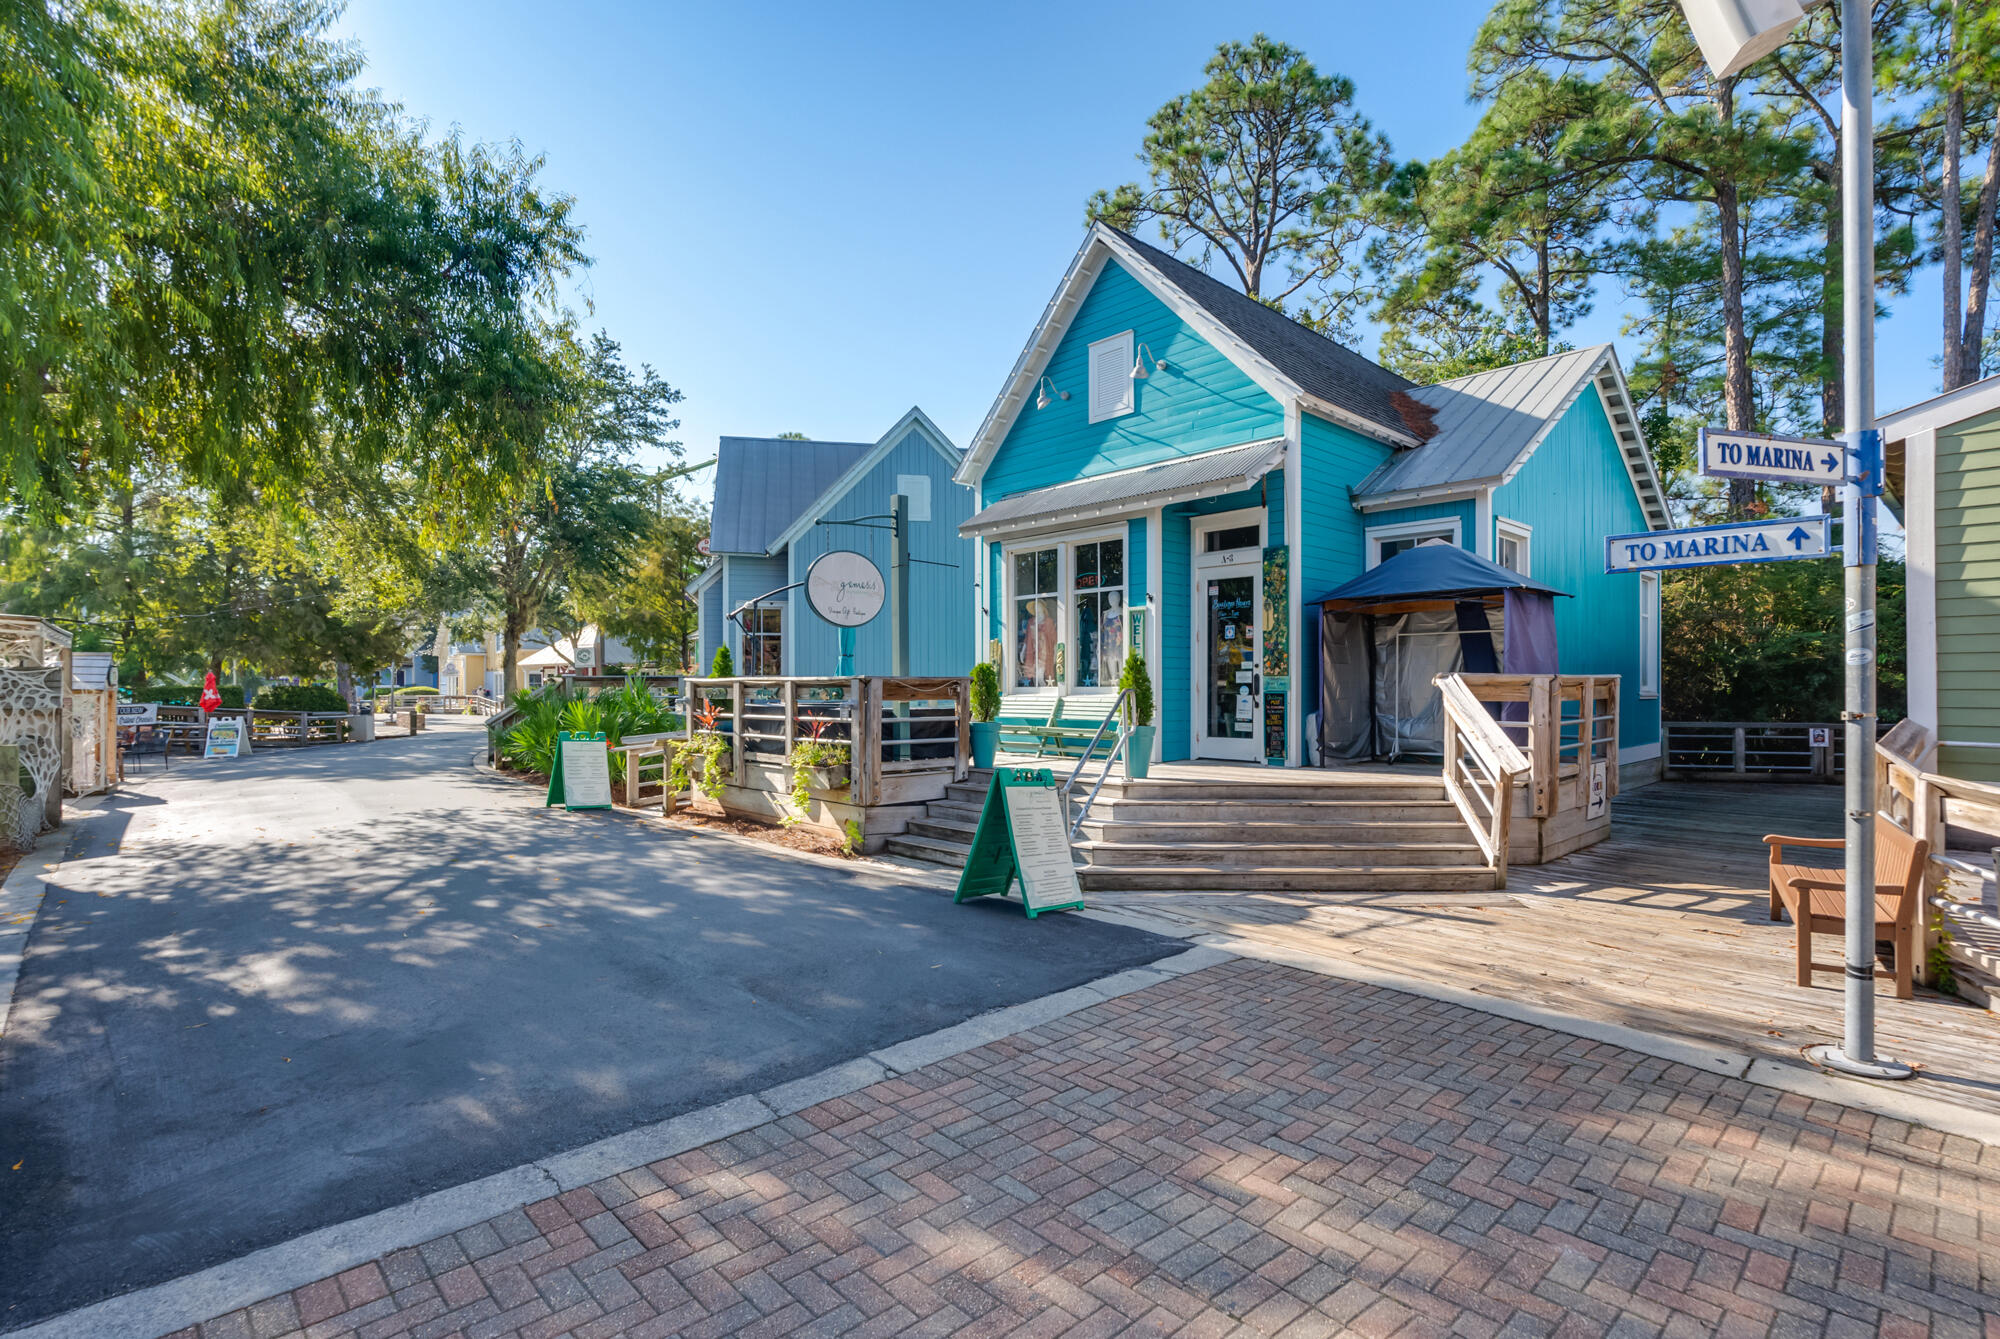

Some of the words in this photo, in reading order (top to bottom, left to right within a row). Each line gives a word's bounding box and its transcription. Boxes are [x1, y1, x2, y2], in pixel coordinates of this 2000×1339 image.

[1718, 442, 1742, 465] TO
[1746, 445, 1815, 471] MARINA
[1625, 543, 1656, 562] TO
[1663, 533, 1770, 560] MARINA
